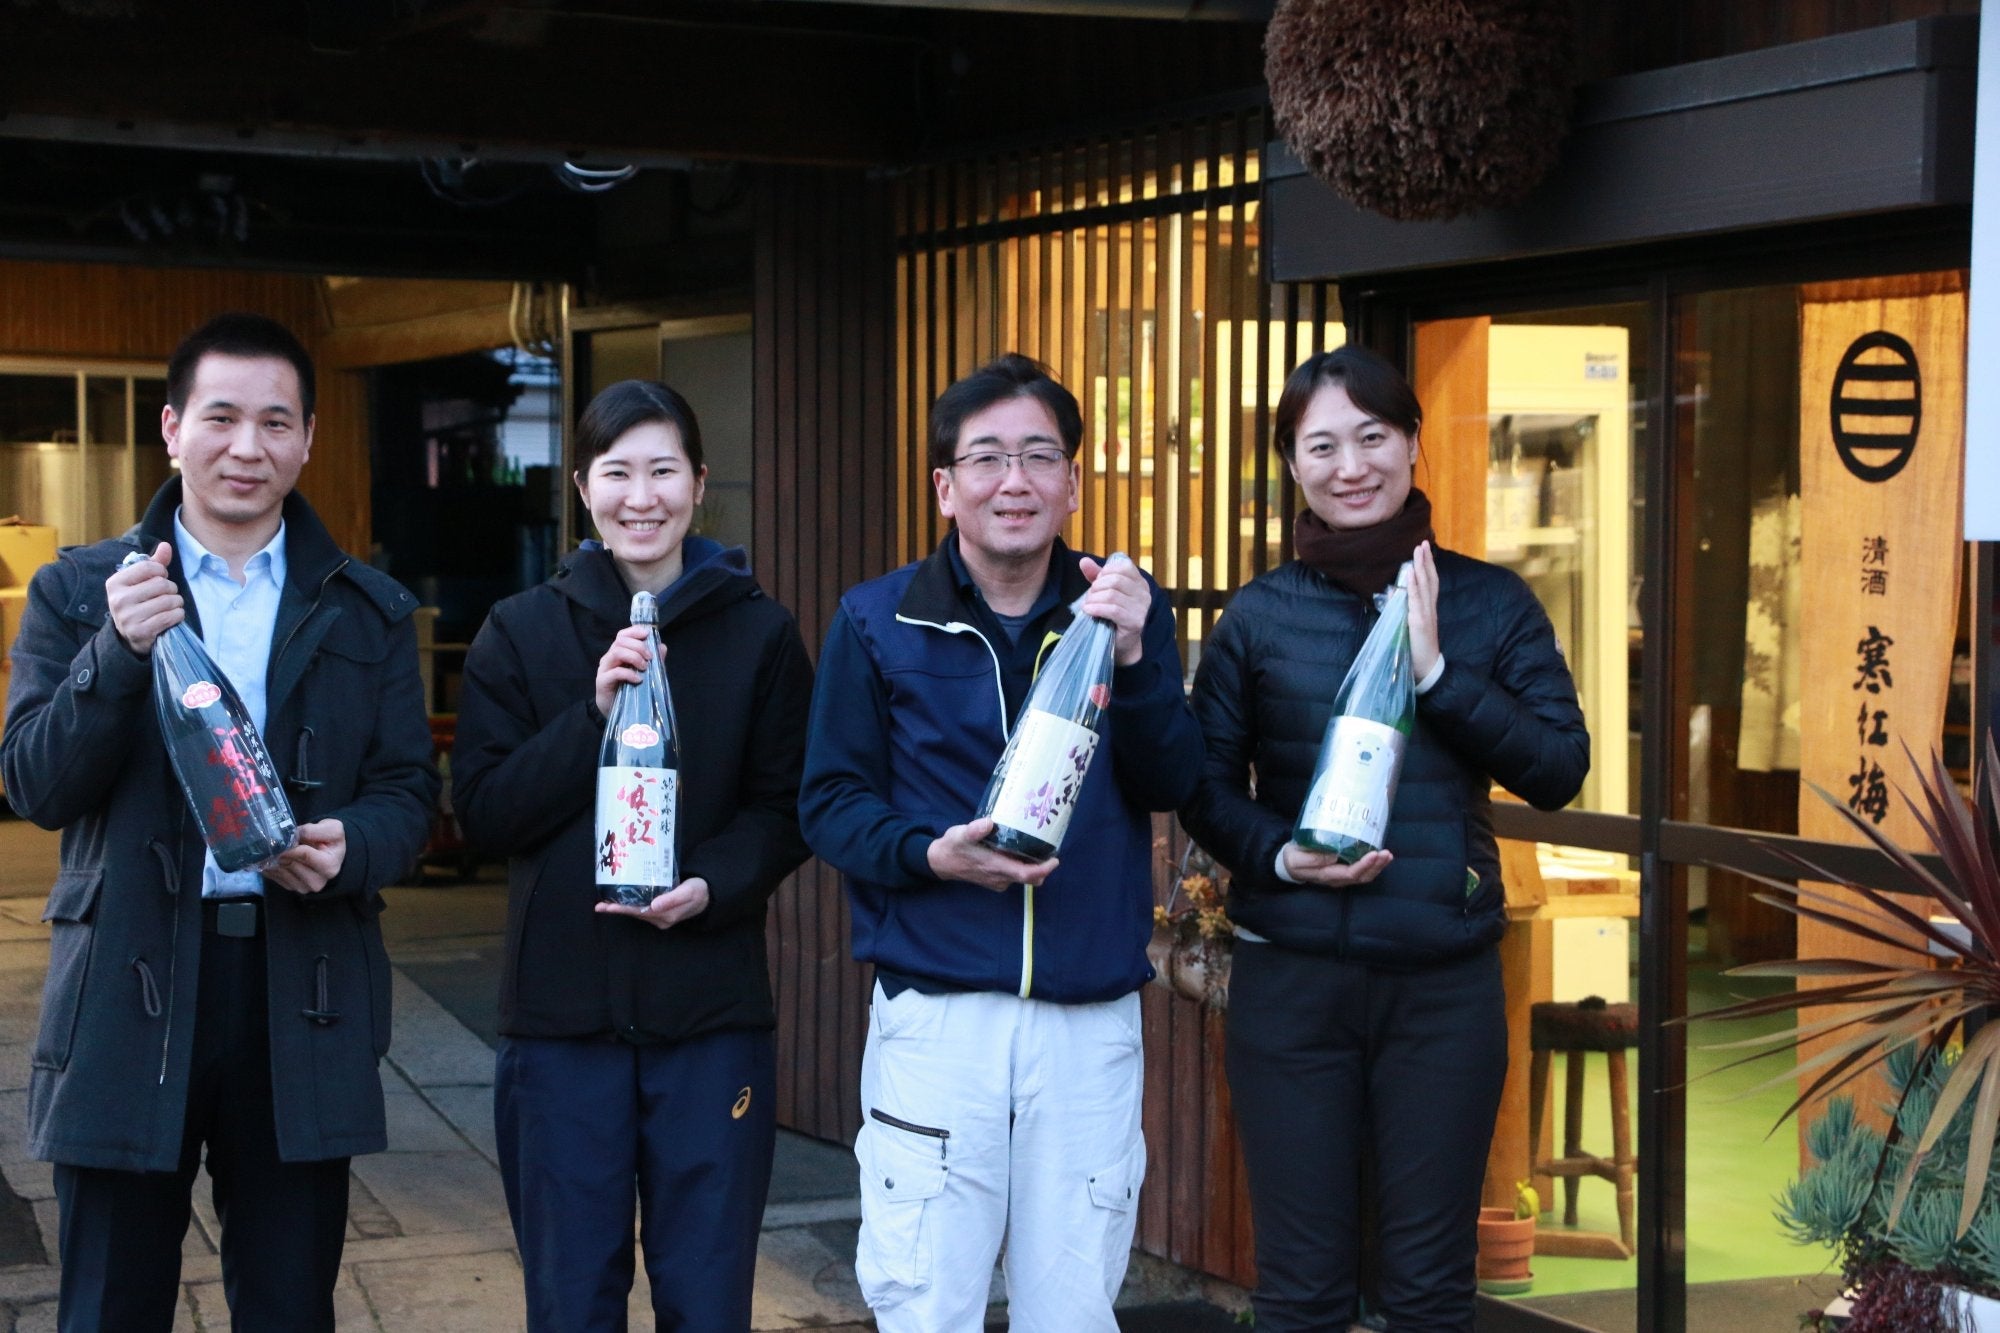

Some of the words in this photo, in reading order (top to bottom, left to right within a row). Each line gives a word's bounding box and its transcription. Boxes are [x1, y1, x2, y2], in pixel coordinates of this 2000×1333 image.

[1861, 536, 1890, 596] 清酒
[1849, 625, 1896, 824] 寒紅梅
[660, 776, 675, 836] 純米吟醸
